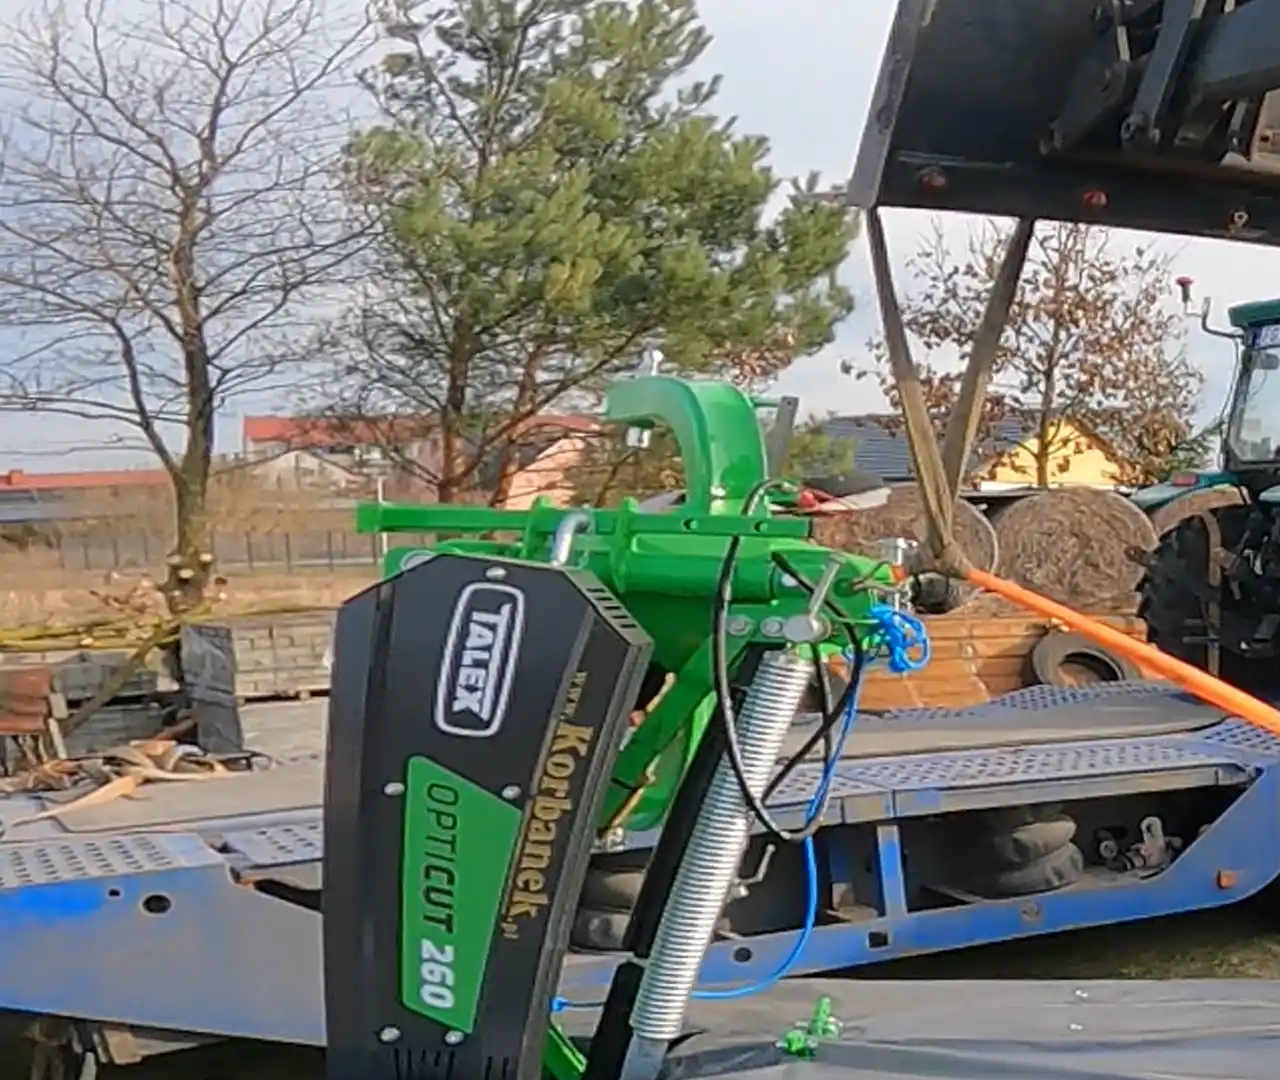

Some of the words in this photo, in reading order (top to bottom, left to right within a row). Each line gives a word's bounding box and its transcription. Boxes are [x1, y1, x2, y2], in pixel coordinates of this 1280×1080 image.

[452, 602, 513, 722] TALEX
[422, 782, 460, 935] OPTICUT
[420, 937, 455, 1009] 260
